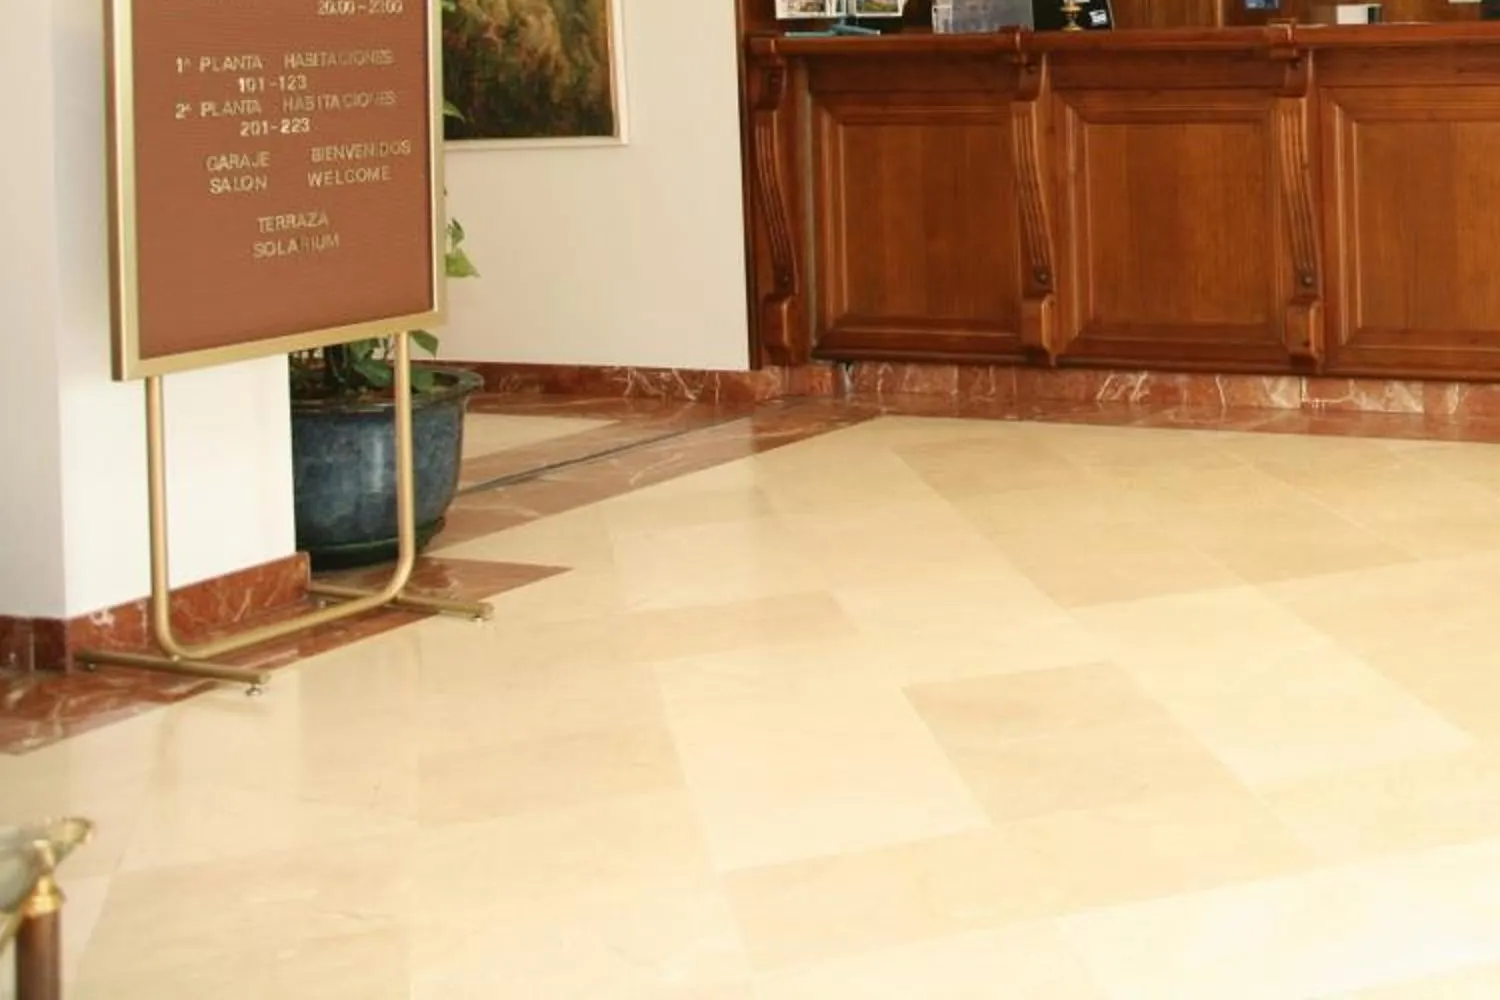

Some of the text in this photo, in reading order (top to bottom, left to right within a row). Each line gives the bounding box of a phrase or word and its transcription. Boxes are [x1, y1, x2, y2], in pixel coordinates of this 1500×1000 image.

[199, 55, 263, 73] PLANTA
[284, 48, 395, 70] HABITACIONES
[200, 99, 263, 118] PLANTA
[282, 90, 398, 114] HABITACIONES
[206, 151, 271, 172] GARAJE
[309, 138, 412, 164] BIENVENIDOS
[208, 174, 268, 195] SALON
[306, 165, 392, 188] WELCOME
[257, 211, 330, 234] TERRAZA
[252, 234, 340, 259] SOLARIUM
